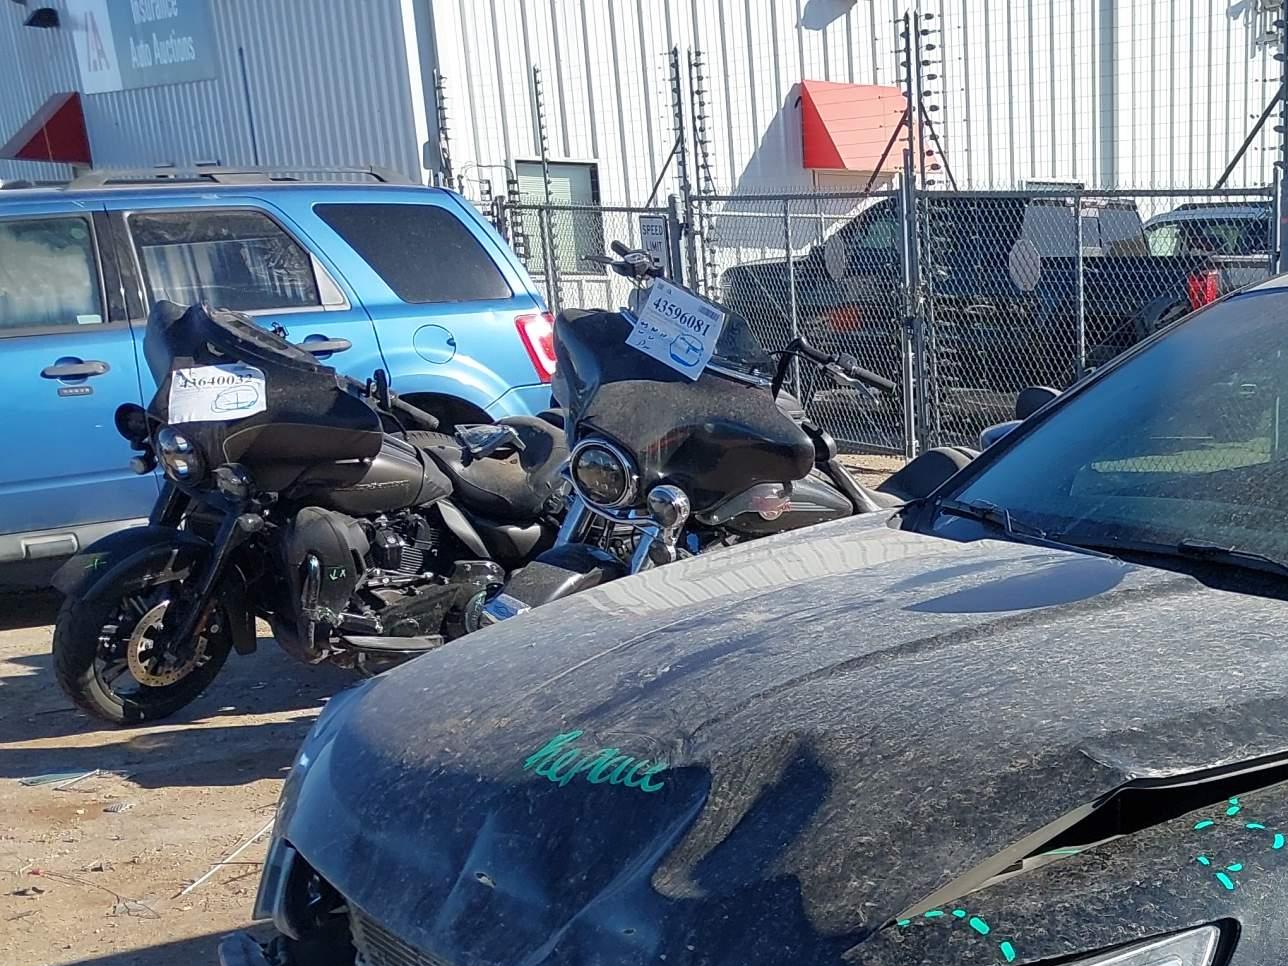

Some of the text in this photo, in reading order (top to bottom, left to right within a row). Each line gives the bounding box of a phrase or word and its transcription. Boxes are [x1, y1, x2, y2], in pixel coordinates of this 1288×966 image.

[130, 0, 179, 24] Insurance
[129, 29, 196, 69] Auto Auctions
[642, 224, 664, 236] SPEED
[653, 297, 711, 337] 43596081
